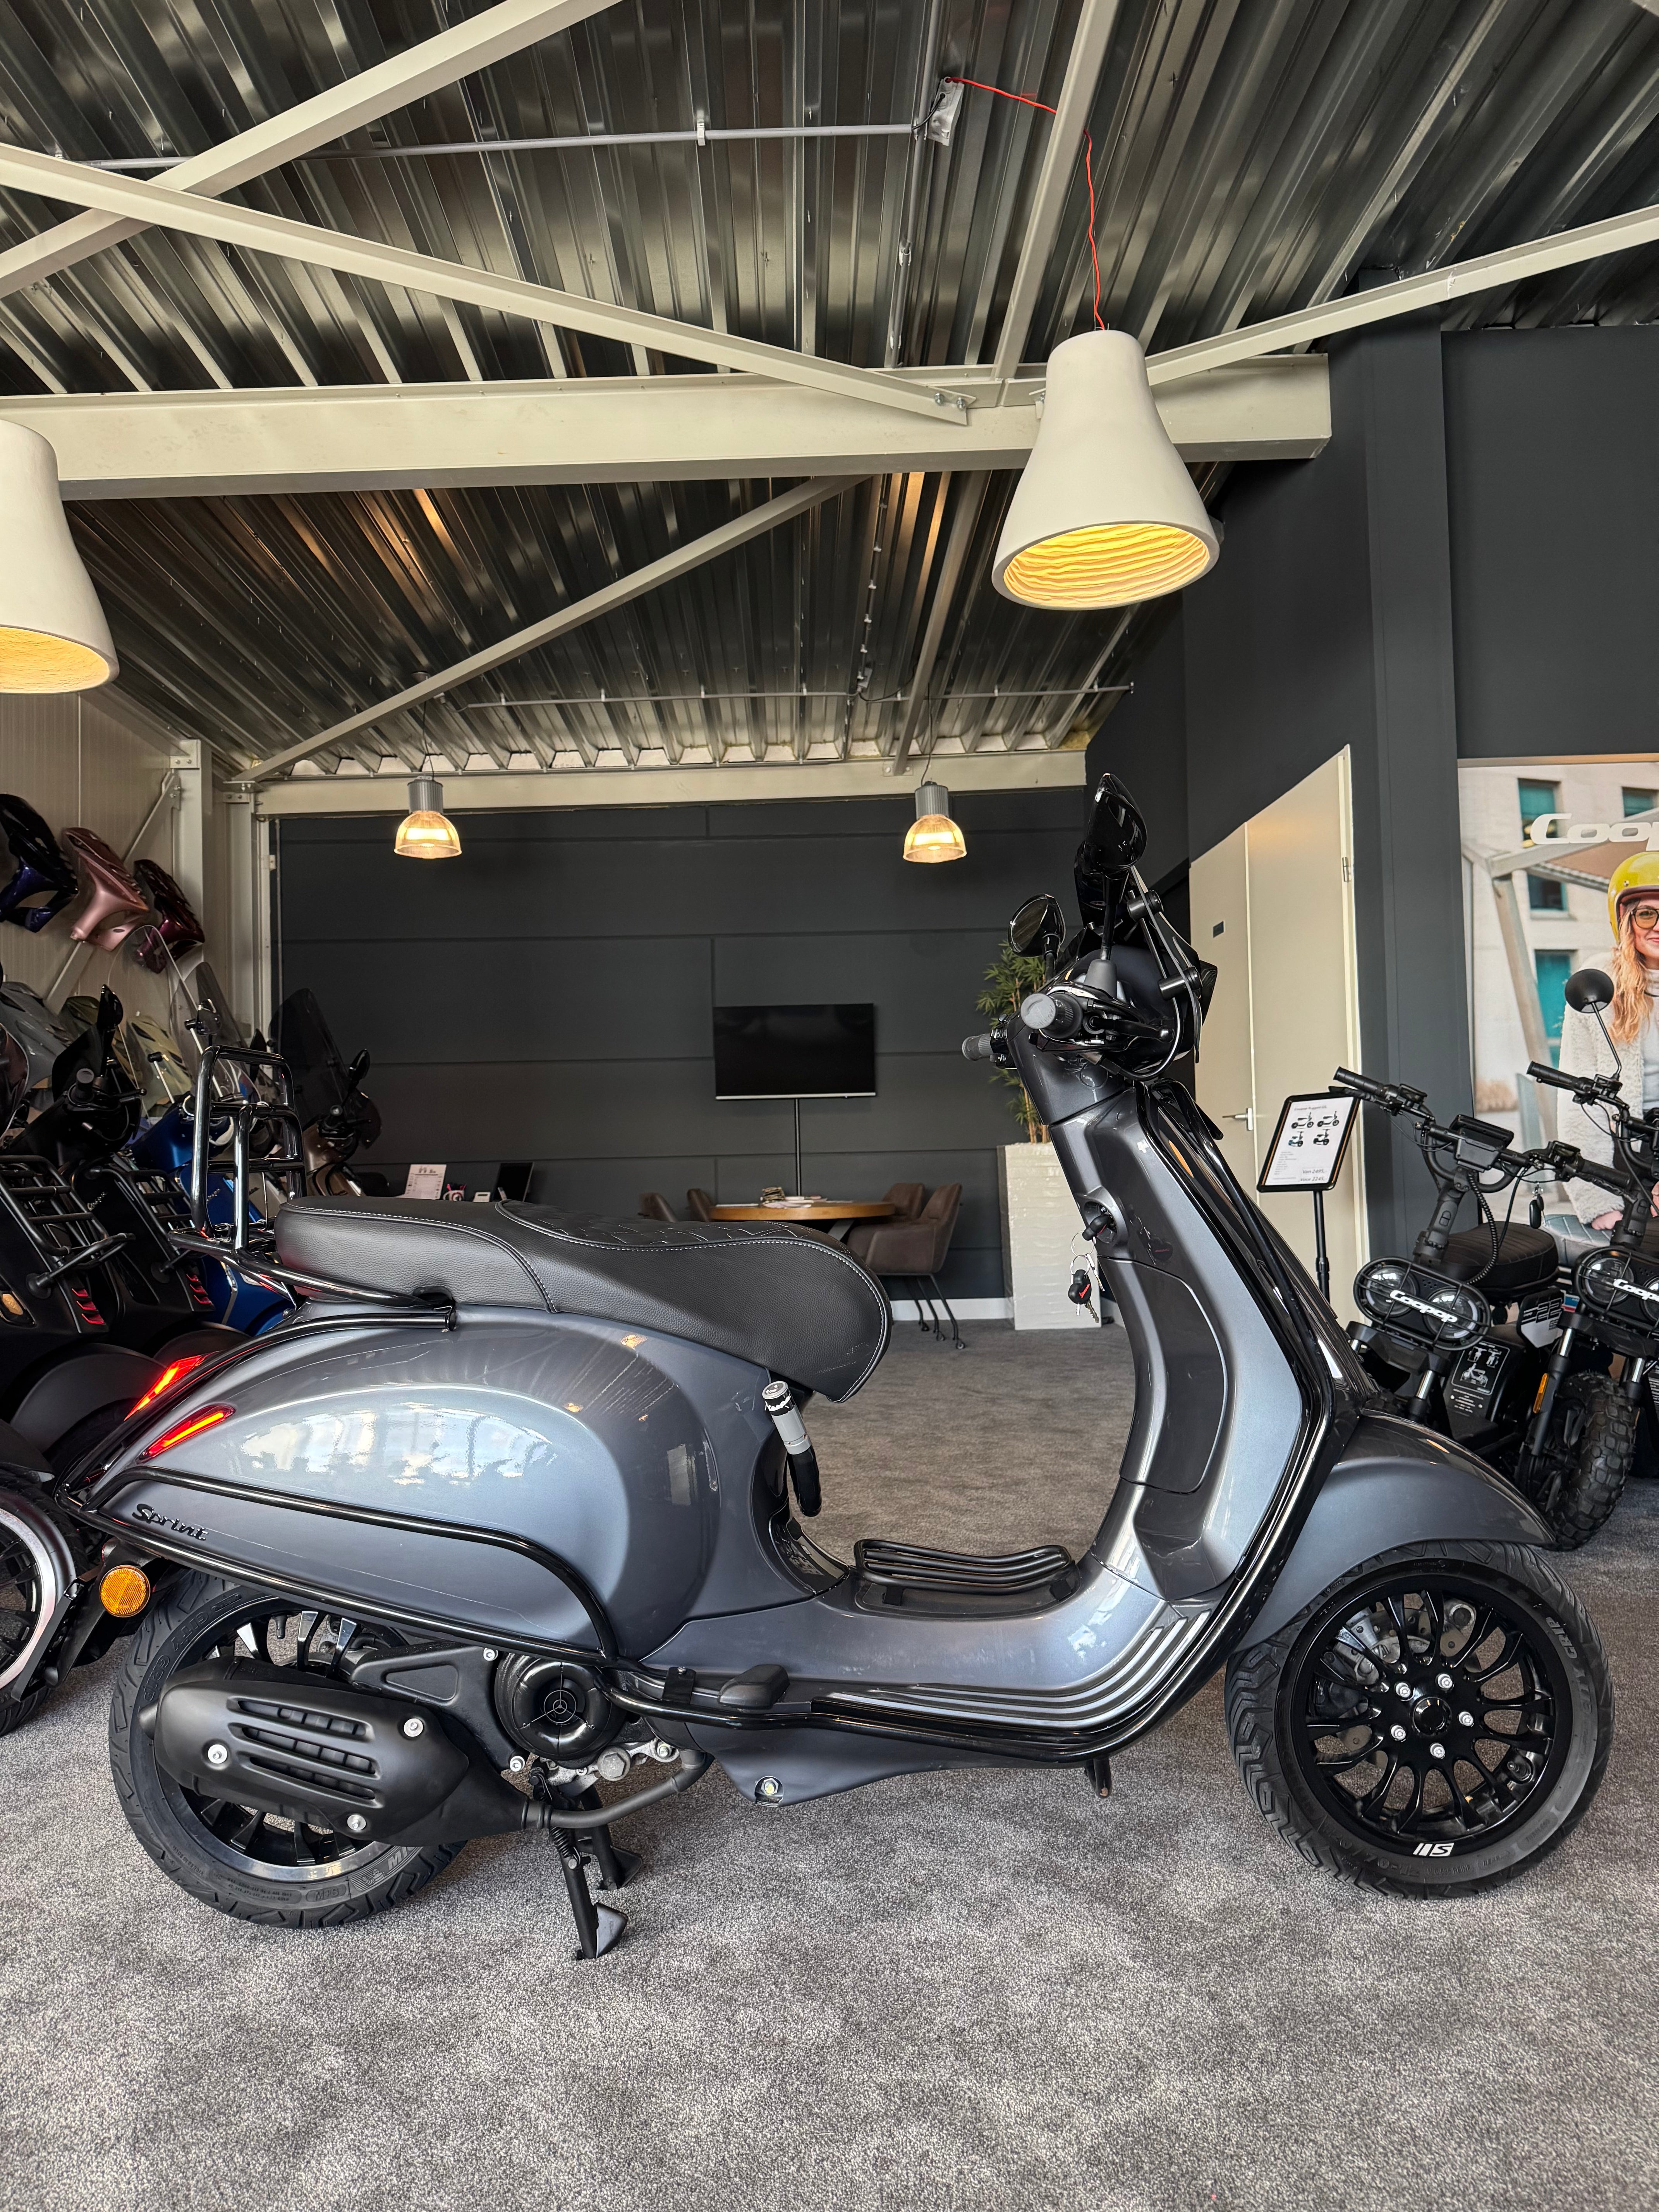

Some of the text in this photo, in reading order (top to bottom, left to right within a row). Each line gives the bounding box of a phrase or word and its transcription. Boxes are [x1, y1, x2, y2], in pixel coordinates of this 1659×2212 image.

[1531, 813, 1659, 851] Coo
[1390, 1290, 1458, 1322] Coopop
[132, 1503, 208, 1540] Sprint
[144, 1612, 209, 1701] CITY GRIP
[1546, 1617, 1577, 1659] GRIP
[388, 1846, 415, 1870] MI
[316, 1887, 339, 1901] M+S
